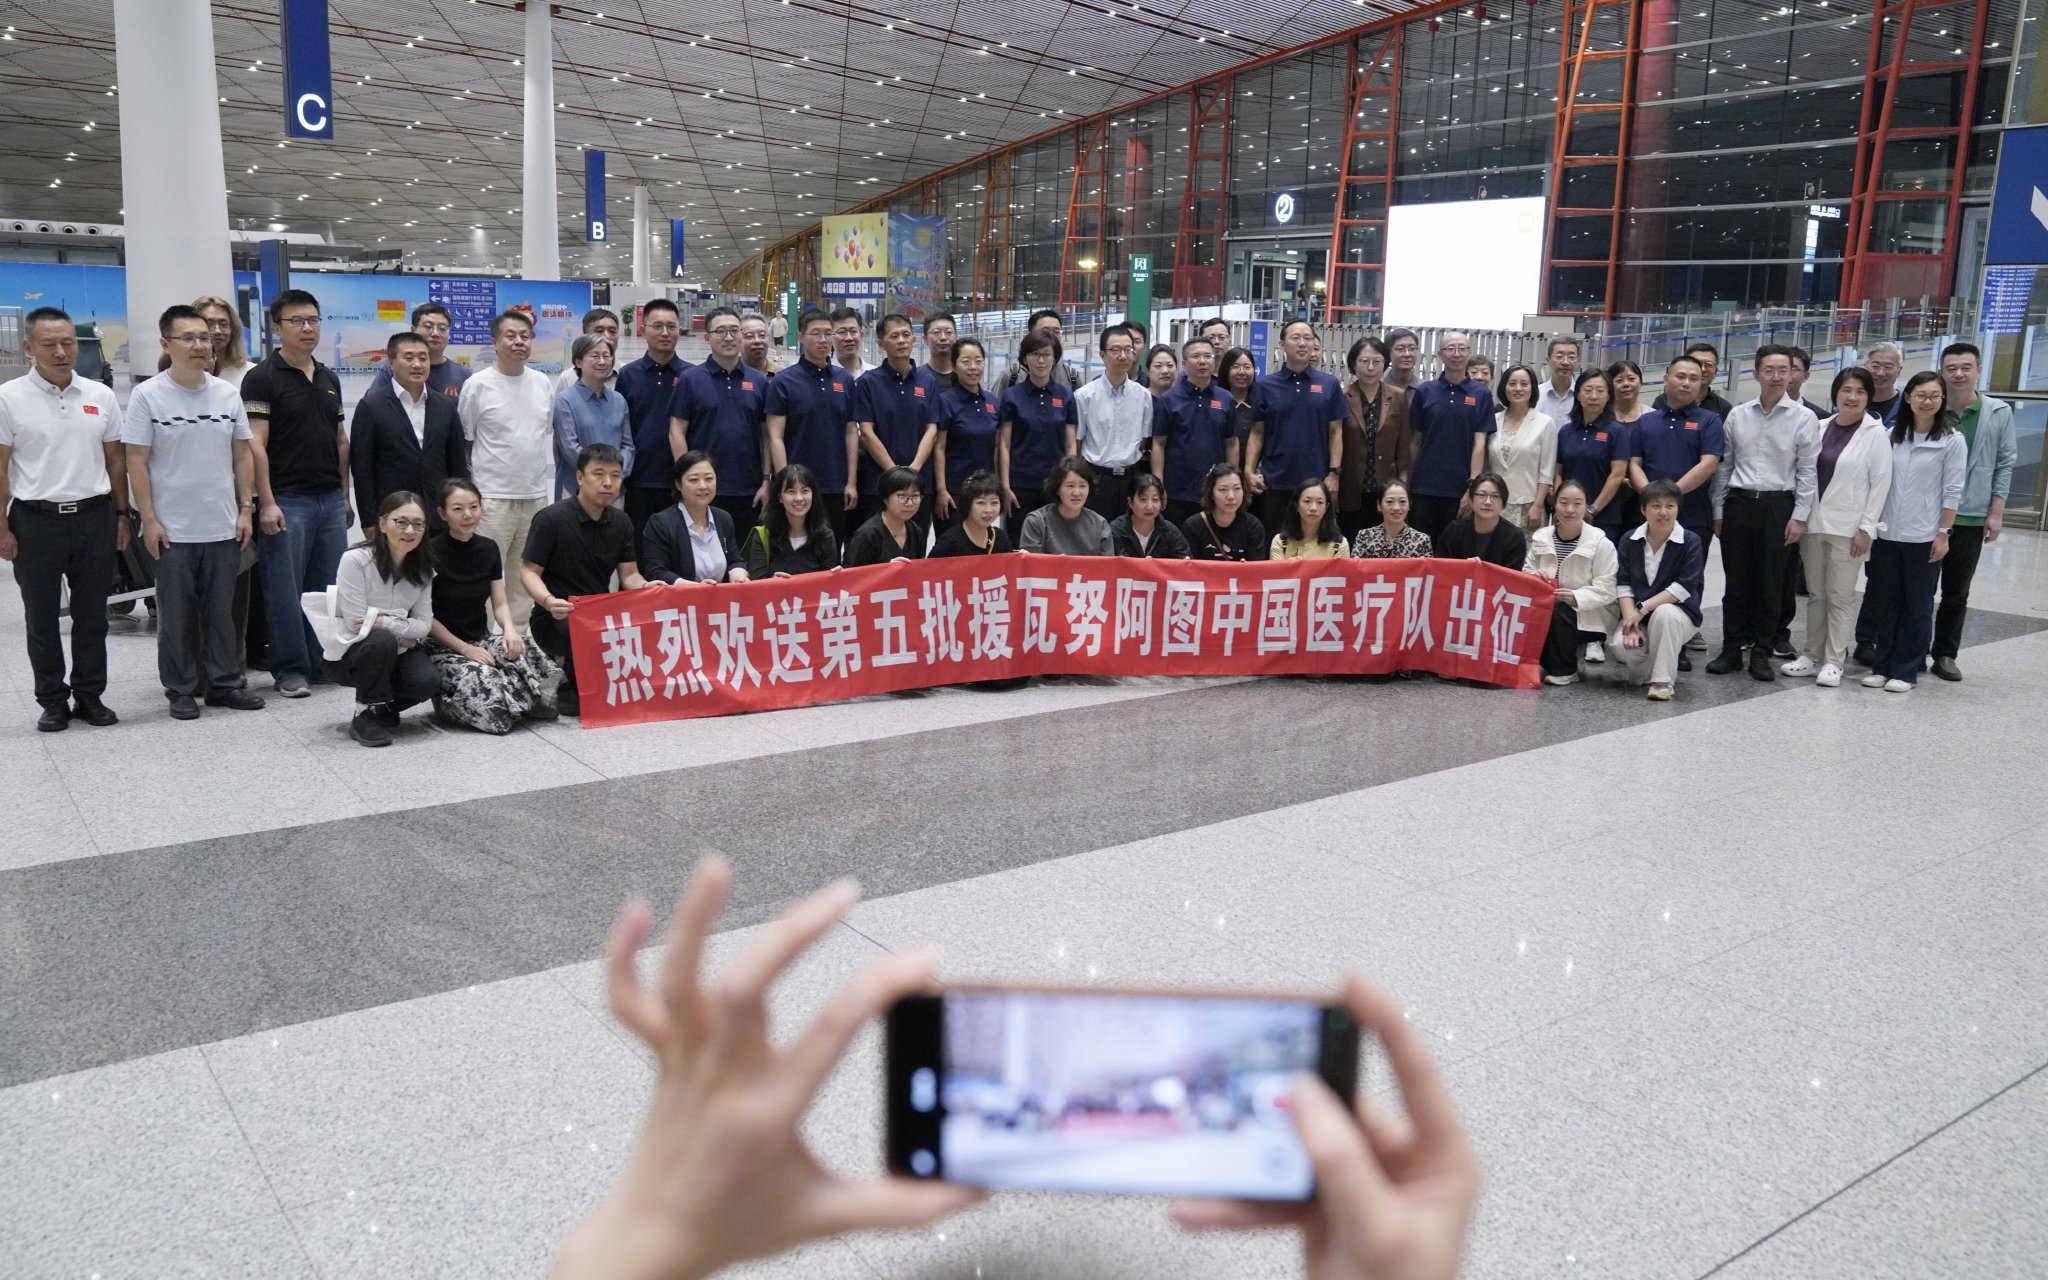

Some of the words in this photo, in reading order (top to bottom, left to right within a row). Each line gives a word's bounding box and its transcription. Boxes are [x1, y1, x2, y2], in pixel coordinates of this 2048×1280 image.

[297, 93, 327, 131] C
[592, 221, 605, 240] B
[675, 264, 684, 277] A
[601, 574, 1532, 706] 热烈欢送第五批援瓦努阿图中国医疗队出征
